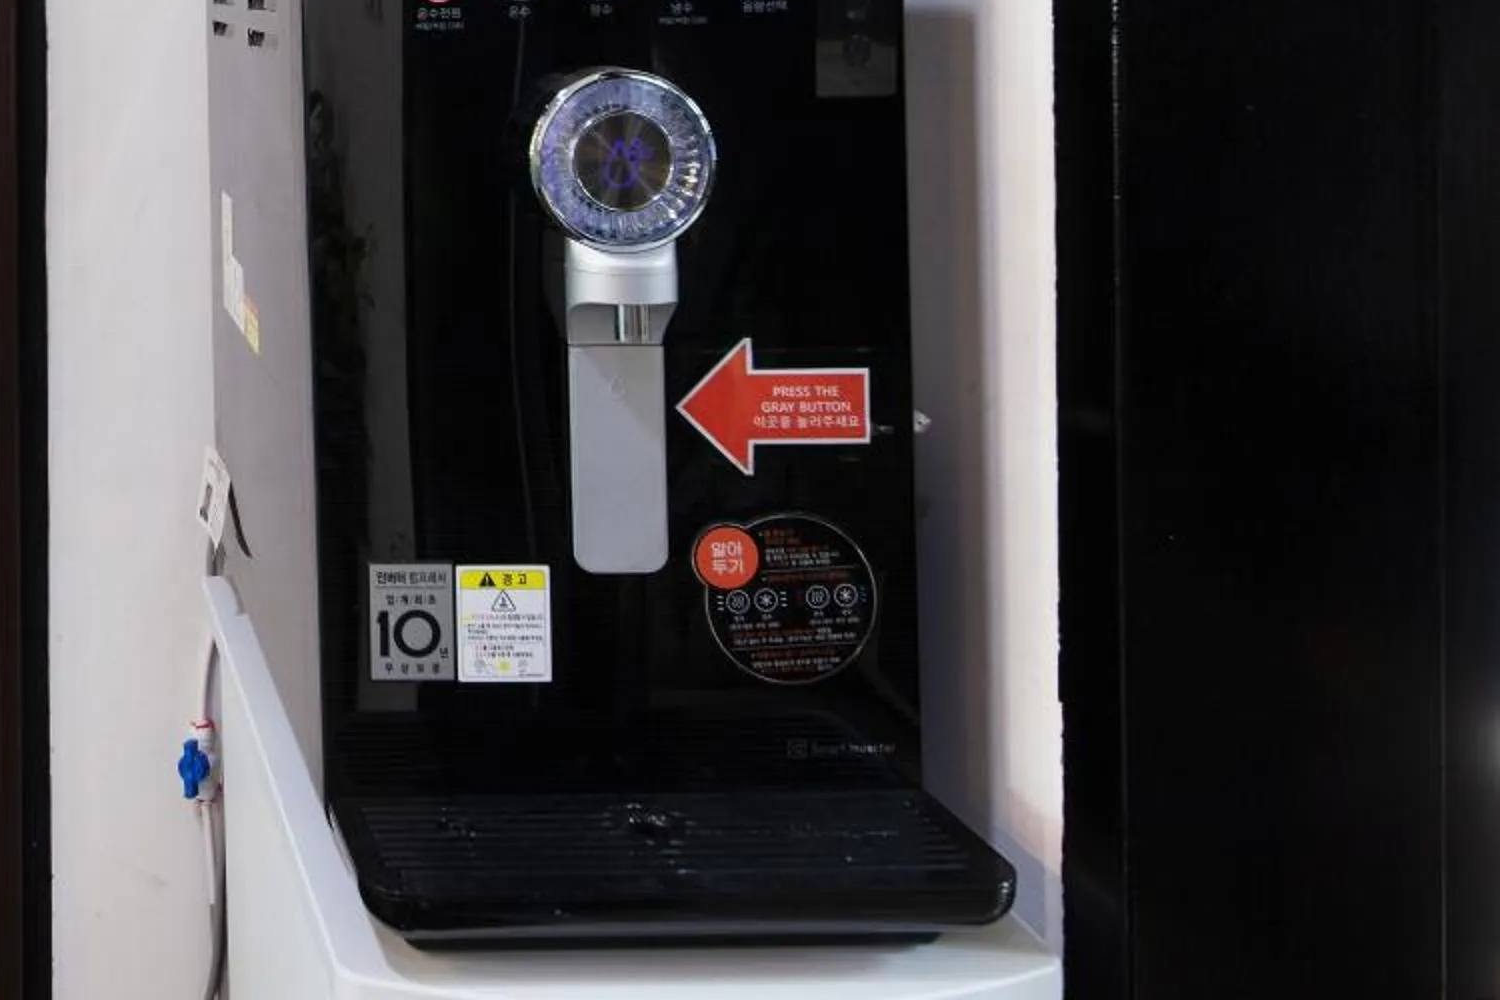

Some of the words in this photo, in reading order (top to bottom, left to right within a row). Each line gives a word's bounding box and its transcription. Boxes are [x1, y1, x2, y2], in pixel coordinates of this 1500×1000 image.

[772, 385, 811, 397] PRESS
[815, 384, 840, 397] THE
[760, 401, 795, 413] GRAY
[799, 401, 851, 413] BUTTON
[711, 541, 743, 558] 알아
[712, 558, 744, 575] 두기
